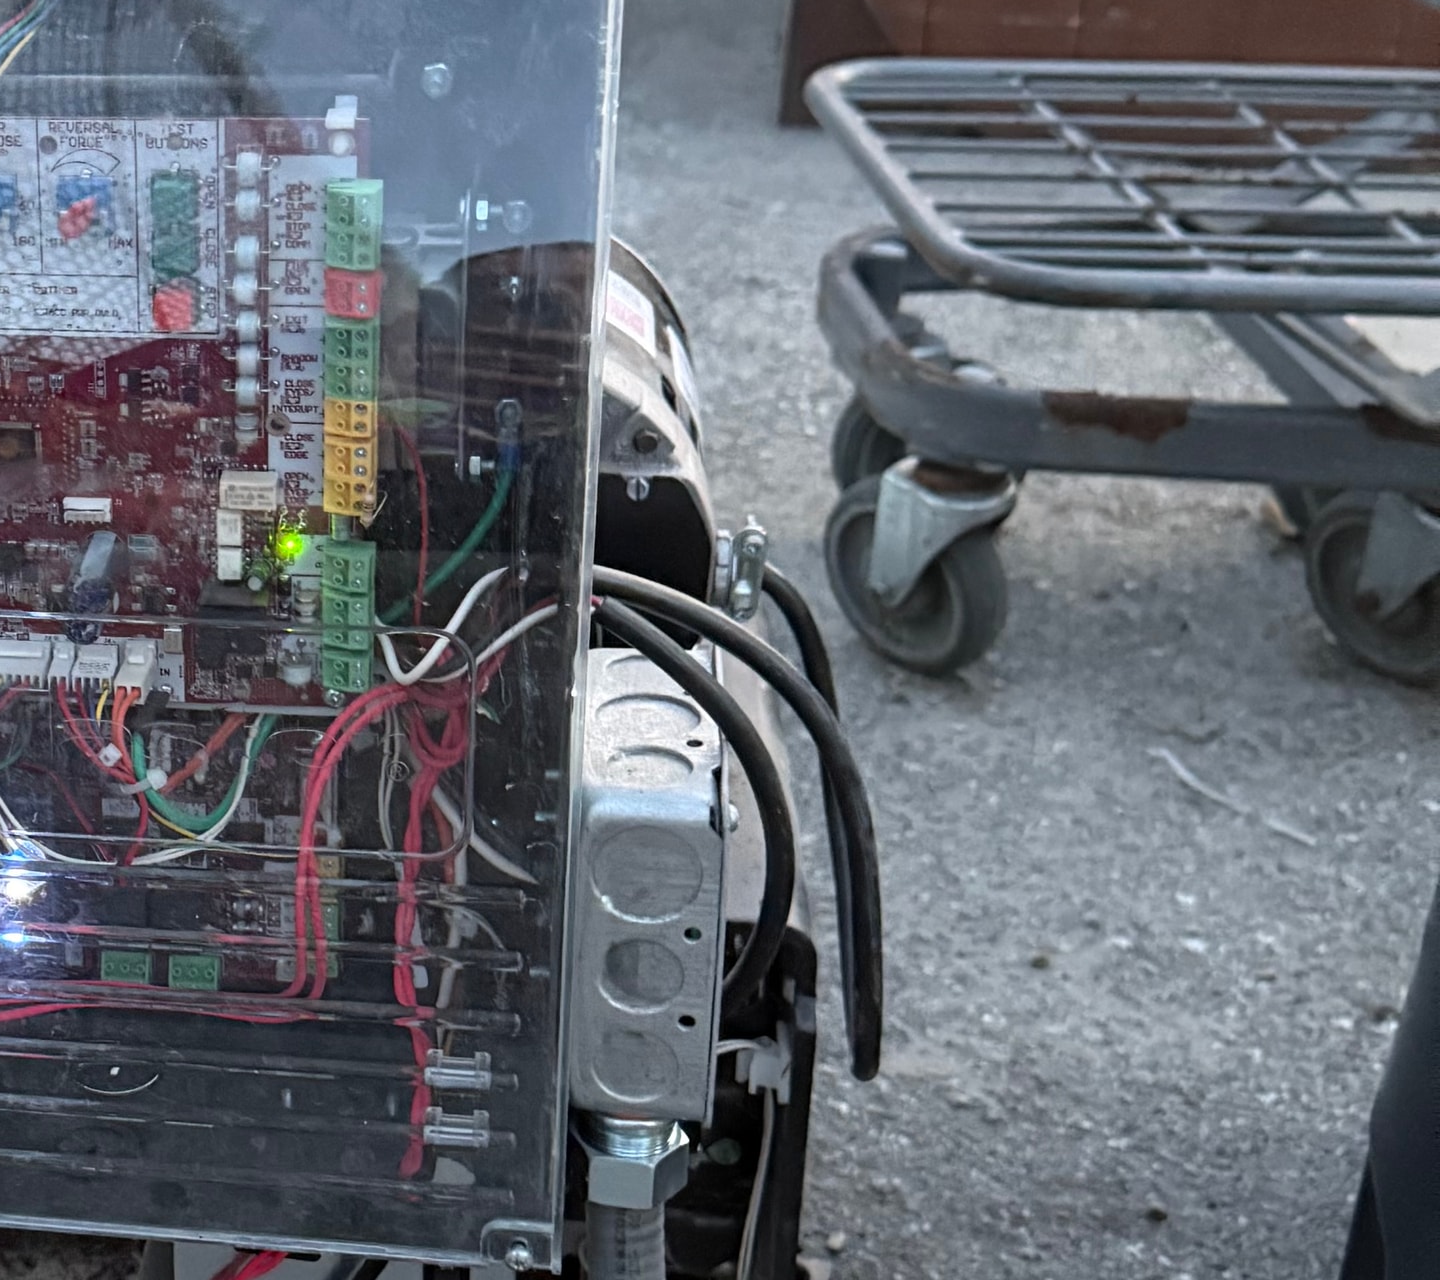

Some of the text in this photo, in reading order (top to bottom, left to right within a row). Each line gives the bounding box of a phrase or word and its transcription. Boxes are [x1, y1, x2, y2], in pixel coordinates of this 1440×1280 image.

[48, 122, 118, 134] REVERSAL
[60, 137, 104, 148] FORCE
[146, 138, 208, 149] BUONS
